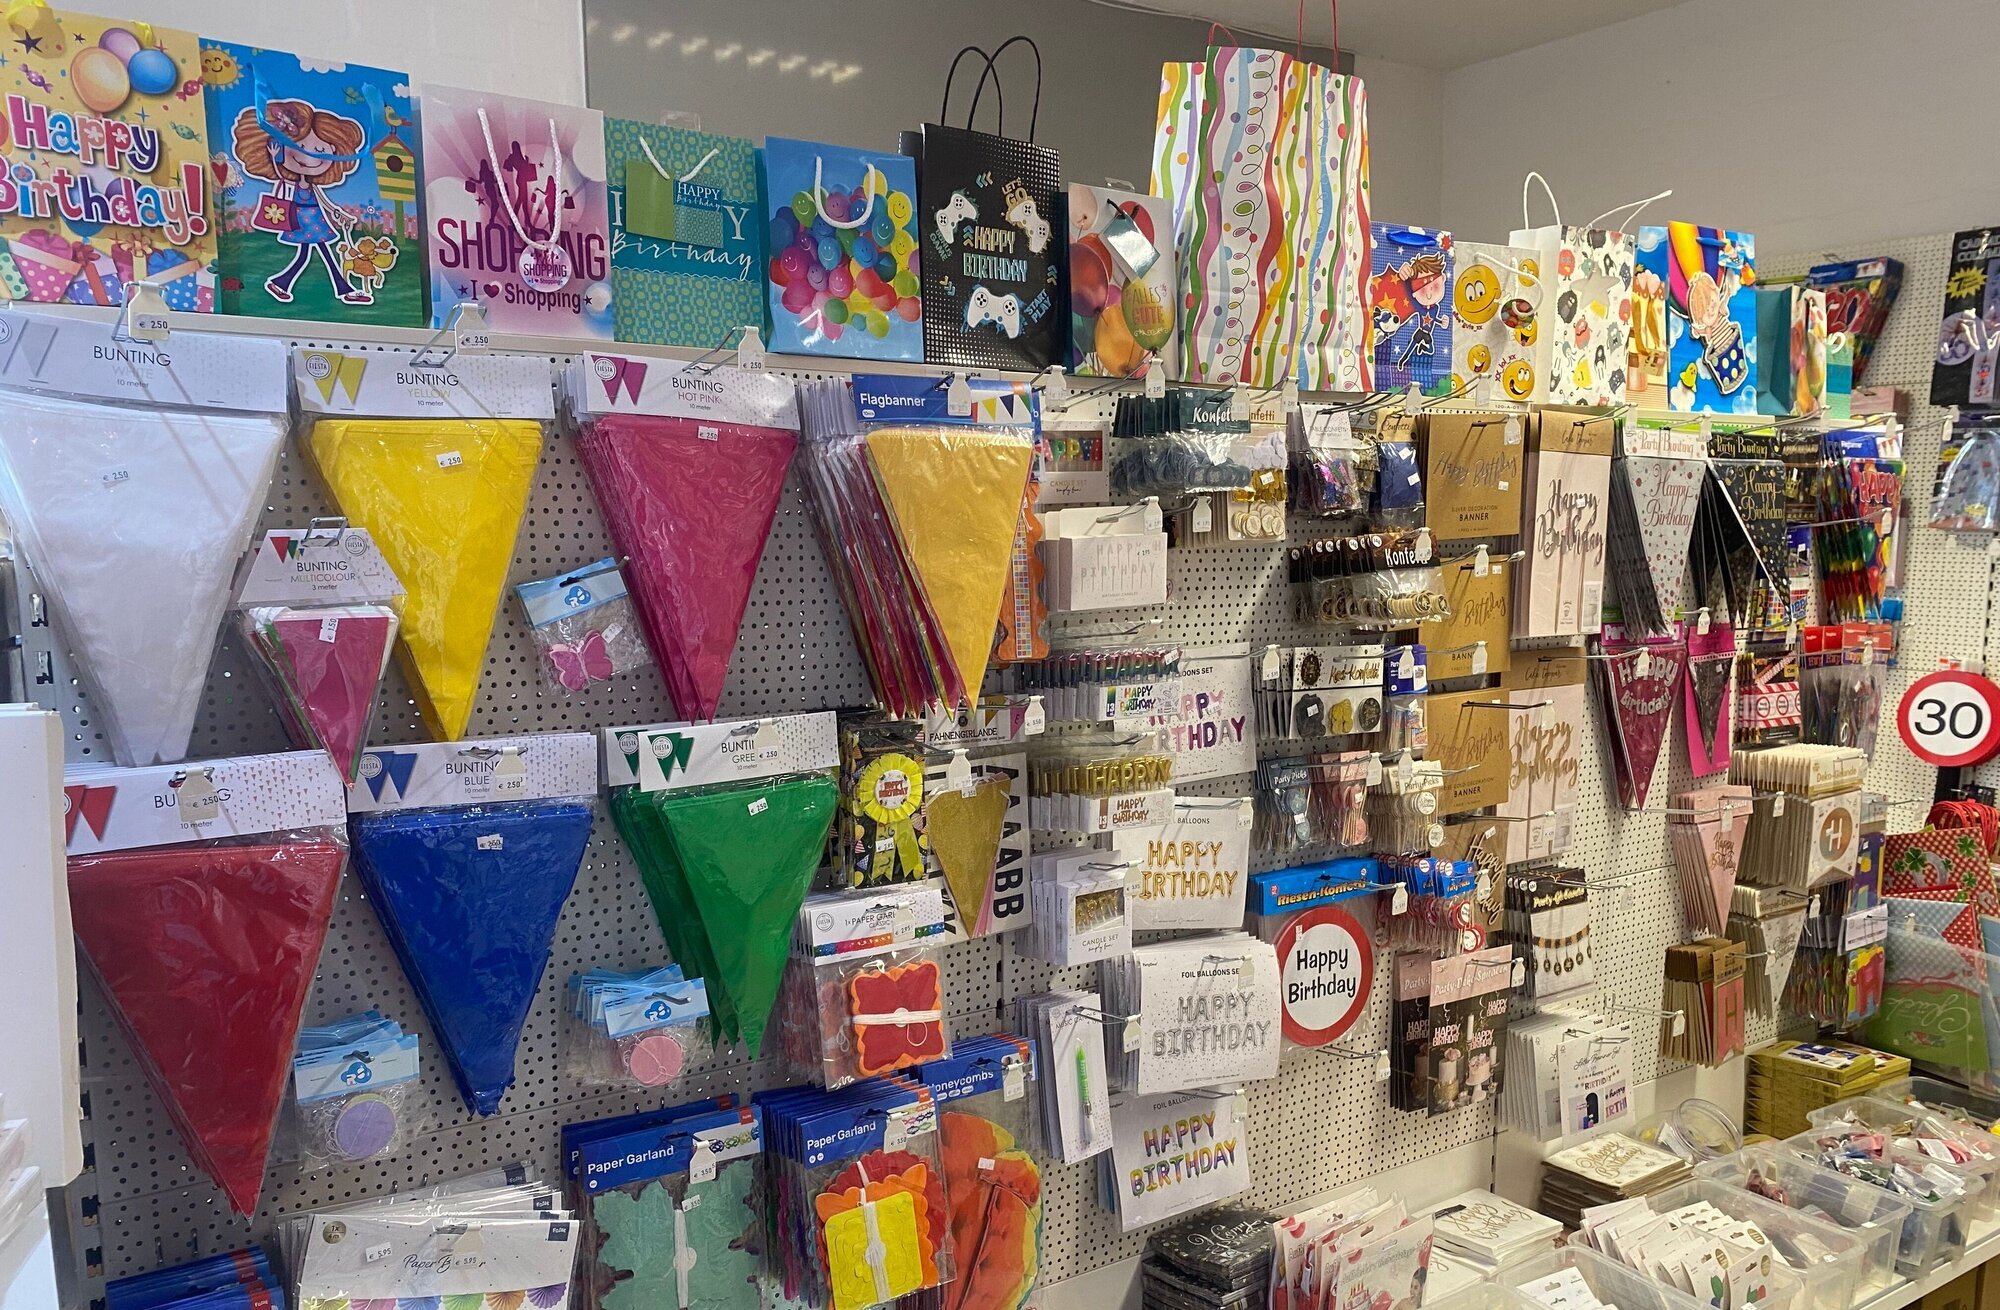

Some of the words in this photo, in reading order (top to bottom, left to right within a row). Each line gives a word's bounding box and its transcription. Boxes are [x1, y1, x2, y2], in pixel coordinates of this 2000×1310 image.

[7, 94, 159, 173] Happy
[677, 182, 720, 199] HAPPY
[1002, 177, 1022, 196] LET'S
[0, 158, 207, 246] Birthday!
[676, 195, 722, 211] Birthday
[1005, 187, 1028, 208] GO
[974, 226, 1016, 254] HAPPY
[437, 217, 606, 281] SHOPNG
[611, 229, 754, 281] Birthday
[523, 263, 567, 278] SHOPPING
[963, 252, 1028, 283] BIRTHDAY
[471, 280, 479, 301] I
[504, 282, 581, 315] Shopping
[1025, 288, 1048, 315] START
[1132, 287, 1161, 304] ALLES
[1031, 300, 1052, 324] PLAY
[150, 320, 169, 330] 2.50
[94, 345, 171, 367] BUNTING
[309, 361, 328, 371] FIESTA
[117, 379, 126, 388] 10
[128, 380, 149, 389] meter
[396, 372, 459, 387] BUNTING
[672, 377, 724, 394] BUNTING
[407, 388, 450, 399] YELLOW
[678, 391, 698, 402] HOT
[700, 394, 721, 405] PINK
[860, 392, 926, 409] Flagbanner
[1638, 432, 1658, 451] Party
[1662, 433, 1694, 453] Bunting
[1716, 436, 1736, 454] Party
[1737, 436, 1768, 455] Bunting
[447, 456, 462, 465] 2.50
[112, 471, 129, 480] 2.50
[1737, 466, 1783, 501] Happy
[1651, 463, 1694, 506] Happy
[1459, 512, 1489, 523] BANNER
[1643, 499, 1695, 537] Birthday
[297, 561, 348, 572] BUNTING
[290, 572, 356, 583] MULTICOLOUR
[1464, 591, 1507, 628] Birthday
[1201, 666, 1214, 676] SET
[1124, 684, 1154, 699] HAPPY
[1620, 687, 1673, 716] Birthday!
[1913, 698, 1984, 740] 30
[929, 727, 998, 742] FAHNENGIRLANDE
[655, 744, 670, 752] FIESTA
[722, 739, 754, 754] BUNTI
[732, 752, 756, 764] GREE
[464, 775, 490, 785] BLUE
[1274, 769, 1308, 785] Party-Picks
[1404, 776, 1440, 792] Party-Picks
[1454, 786, 1482, 798] BANNER
[203, 796, 218, 806] 2.50
[1117, 796, 1146, 811] HAPPY
[190, 820, 213, 829] meter
[1177, 816, 1210, 825] BALLOONS
[1148, 839, 1224, 869] HAPPY
[1140, 870, 1239, 901] IRTHDAY
[851, 913, 875, 925] PAPER
[869, 919, 891, 929] CLASSIC
[1082, 935, 1106, 947] CANDLE
[1106, 933, 1119, 944] SET
[1296, 948, 1348, 974] Happy
[1181, 971, 1196, 979] FOIL
[1197, 968, 1231, 978] BALLOONS
[1288, 973, 1357, 1005] Birthday
[1177, 991, 1254, 1025] HAPPY
[1152, 1019, 1271, 1058] BIRTHDAY
[1432, 1033, 1461, 1047] BIRTHDAY
[1434, 1023, 1461, 1040] HAPPY
[928, 1071, 994, 1093] oneycombs
[1153, 1102, 1167, 1111] FOIL
[807, 1134, 837, 1150] Paper
[838, 1121, 877, 1141] Garland
[1143, 1110, 1217, 1158] HAPPY
[587, 1157, 625, 1175] Paper
[626, 1145, 675, 1165] Garland
[1129, 1136, 1238, 1199] BIRTHDAY
[378, 1247, 392, 1258] 5.95
[463, 1256, 477, 1265] 5.95
[403, 1254, 437, 1275] Paper
